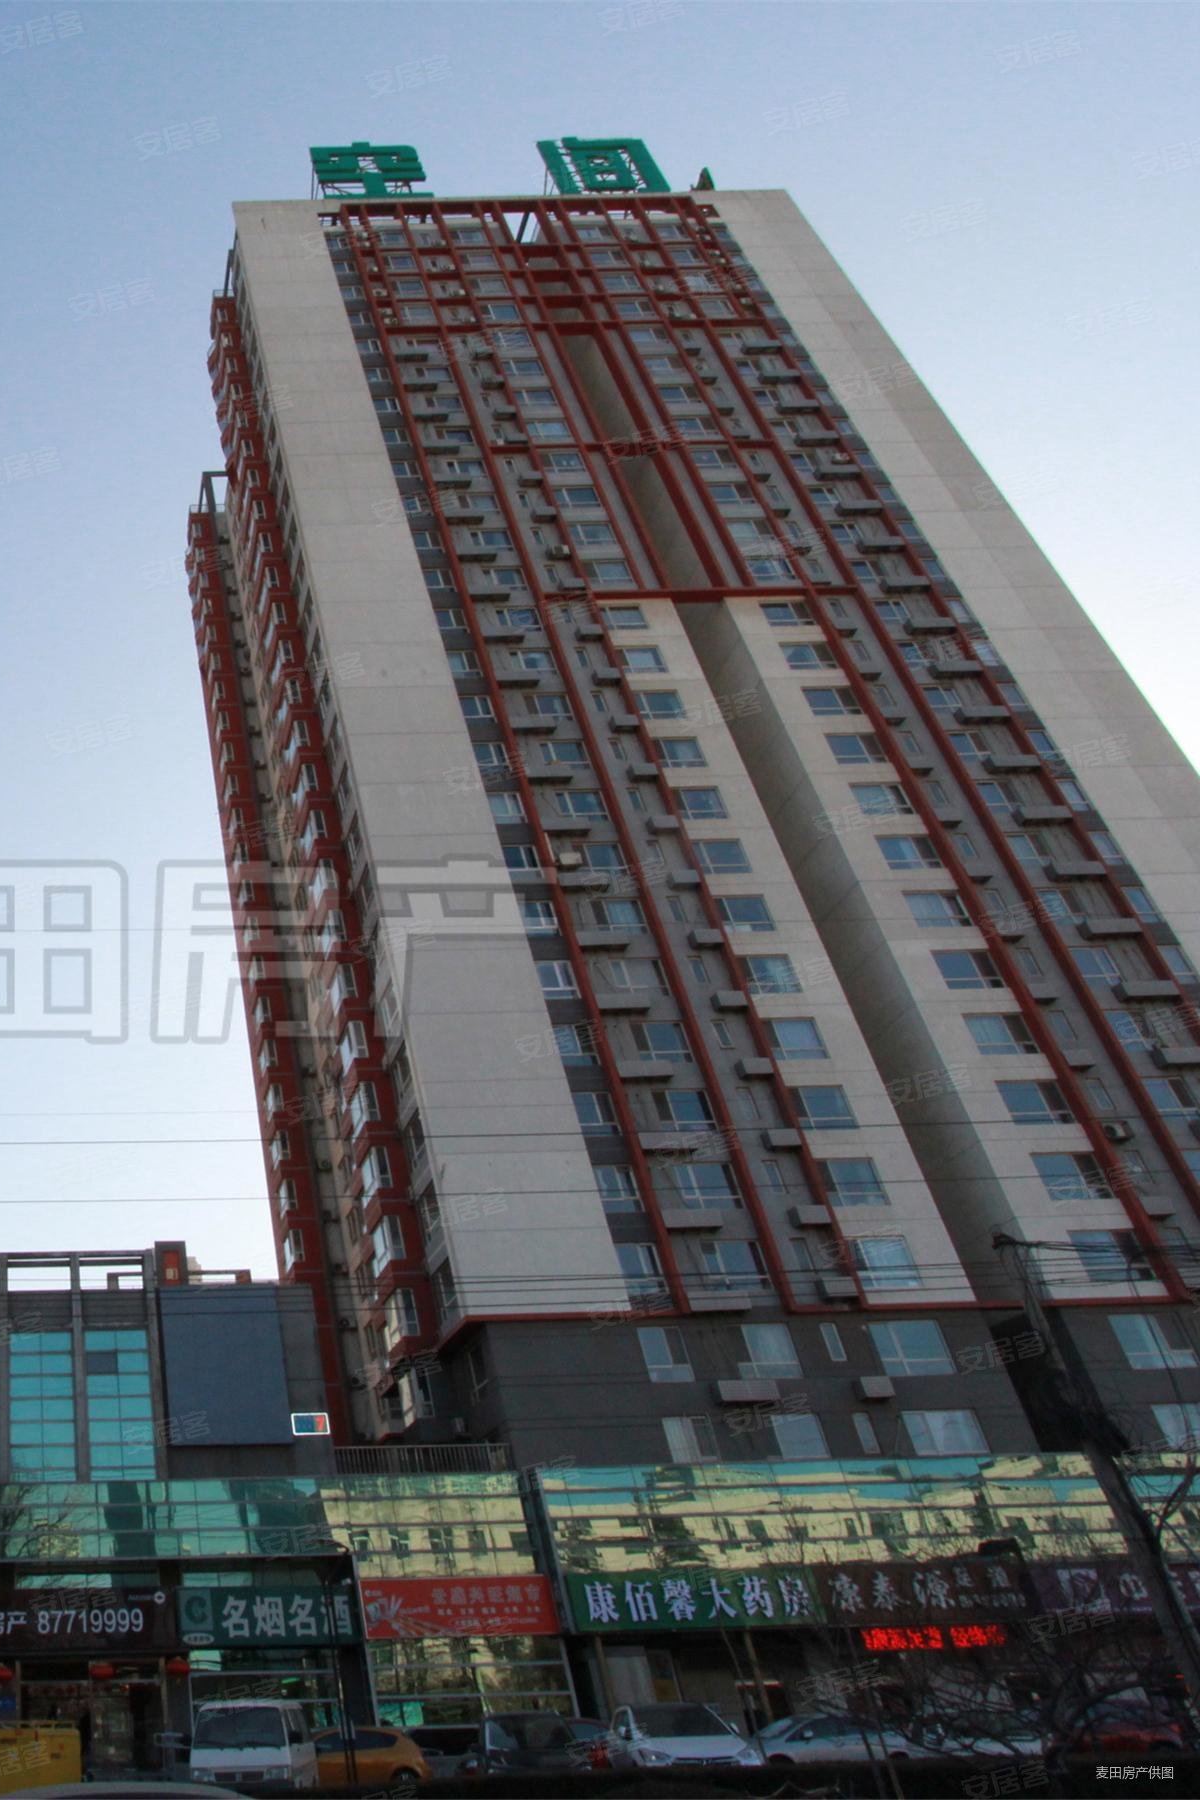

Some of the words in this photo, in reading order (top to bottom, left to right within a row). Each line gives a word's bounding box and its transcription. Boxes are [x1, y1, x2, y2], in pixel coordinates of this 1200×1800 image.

[36, 1607, 144, 1635] 87719999
[221, 1594, 353, 1639] 名烟名酒
[583, 1575, 815, 1623] 康佰馨大药房
